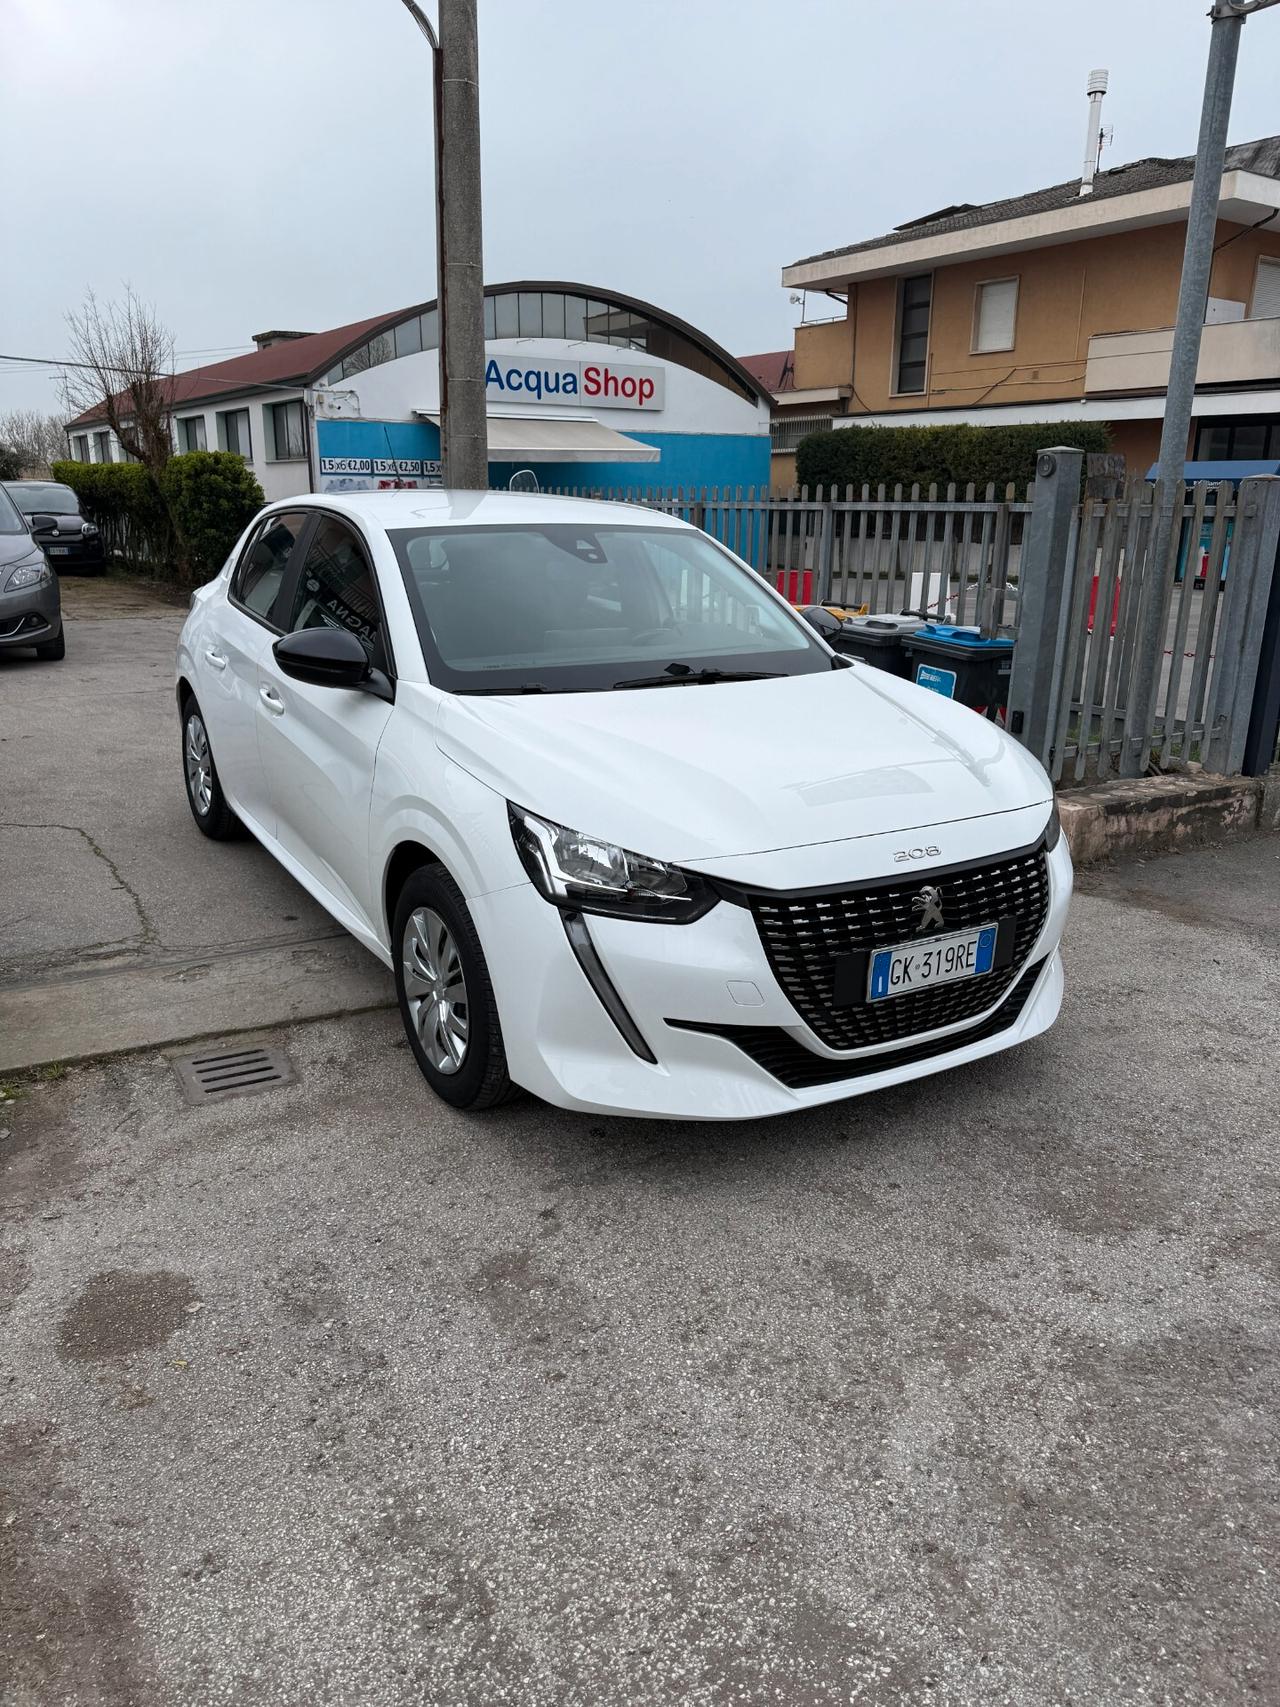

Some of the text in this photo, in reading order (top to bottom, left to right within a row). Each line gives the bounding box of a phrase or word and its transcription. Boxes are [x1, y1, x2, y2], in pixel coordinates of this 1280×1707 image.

[485, 359, 655, 406] Acqua Shop
[322, 459, 370, 472] 1,5 x6 €2,00
[375, 460, 387, 472] 1,5
[399, 461, 420, 473] €2,50
[893, 845, 942, 863] 208
[890, 954, 915, 986] GK
[921, 940, 977, 979] 319RE
